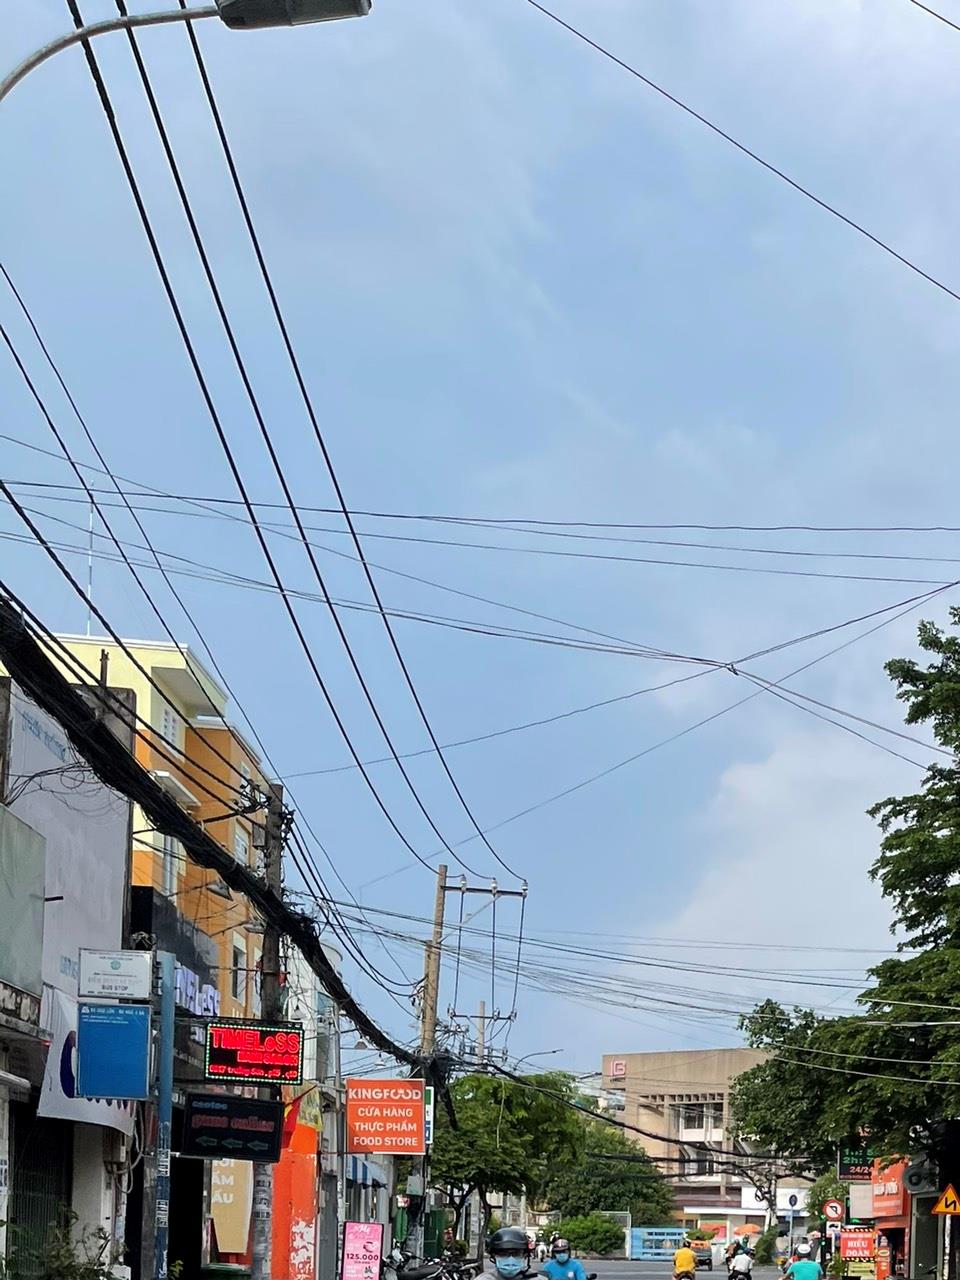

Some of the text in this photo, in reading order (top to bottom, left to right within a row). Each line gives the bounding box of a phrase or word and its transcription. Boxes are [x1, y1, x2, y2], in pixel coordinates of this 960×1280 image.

[348, 1087, 422, 1100] KINGFOOD
[353, 1136, 419, 1147] FOOD STORE
